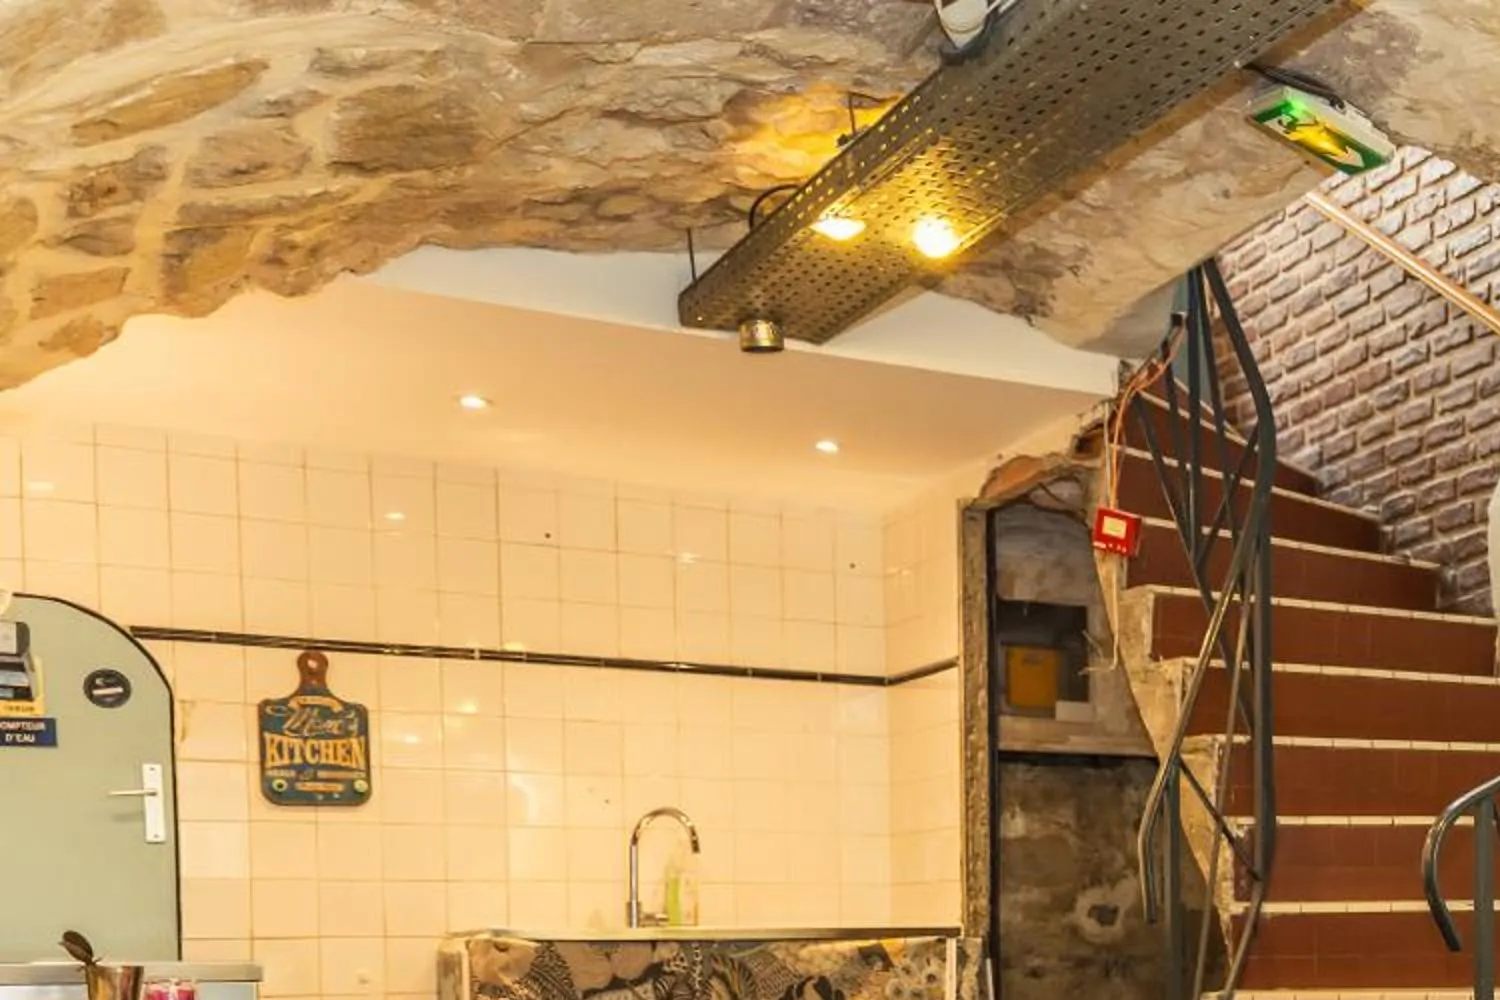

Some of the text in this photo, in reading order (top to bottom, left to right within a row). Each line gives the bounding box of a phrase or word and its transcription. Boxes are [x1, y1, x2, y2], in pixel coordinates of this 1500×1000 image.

[0, 721, 46, 731] OMPTEUR
[5, 732, 36, 743] D'EAU
[264, 731, 366, 770] KITCHEN
